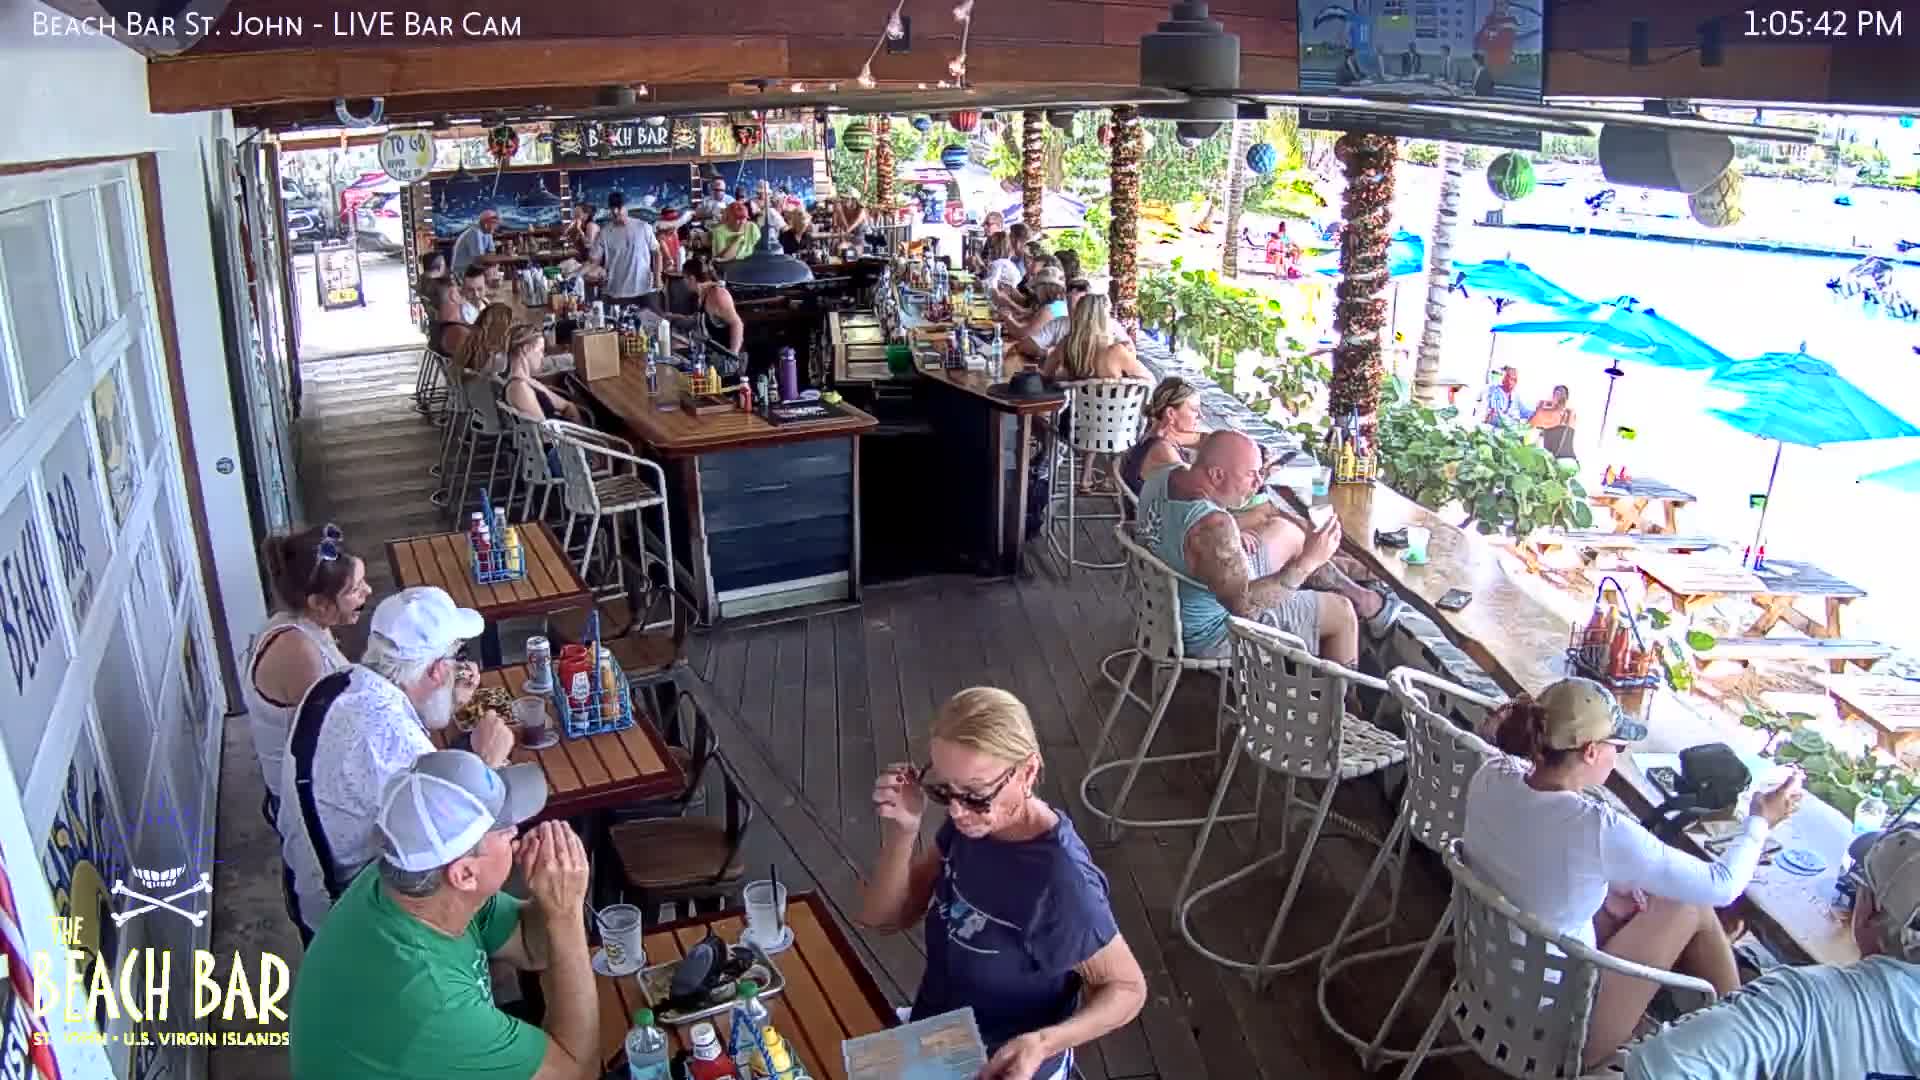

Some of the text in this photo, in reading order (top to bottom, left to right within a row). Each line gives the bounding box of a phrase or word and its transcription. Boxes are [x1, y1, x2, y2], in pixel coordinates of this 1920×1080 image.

[386, 133, 426, 156] TO GO
[588, 126, 669, 147] BCH BAR
[47, 471, 87, 588] BAR
